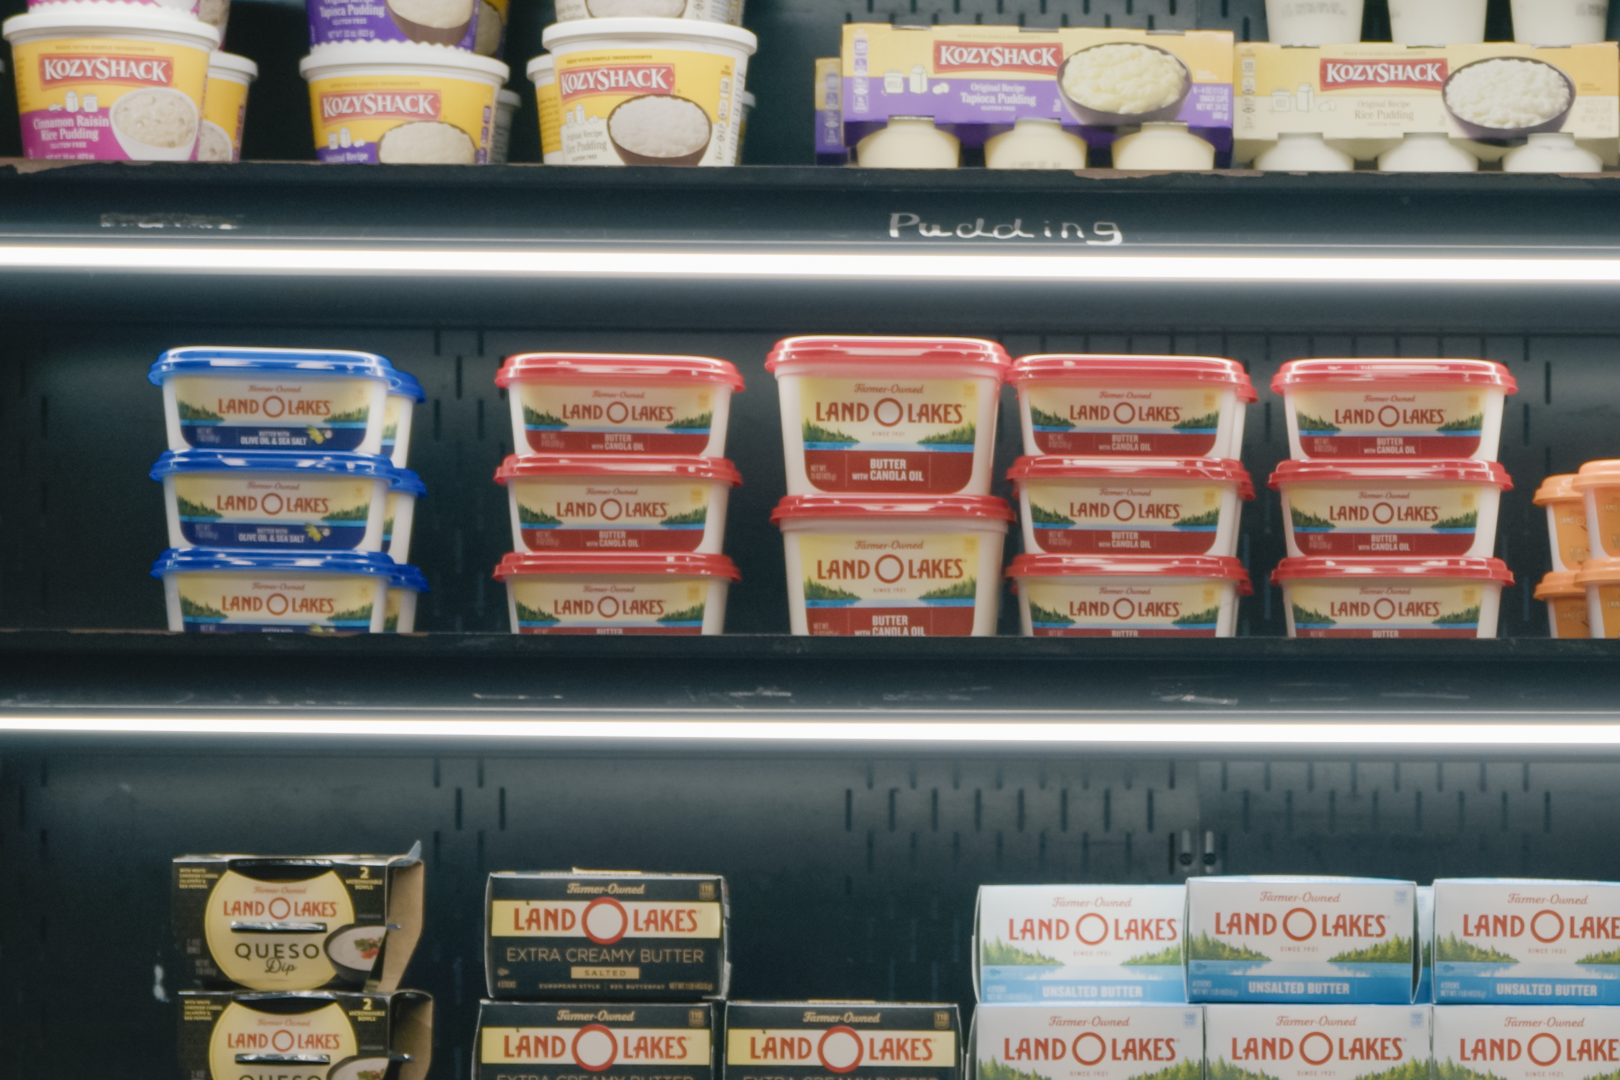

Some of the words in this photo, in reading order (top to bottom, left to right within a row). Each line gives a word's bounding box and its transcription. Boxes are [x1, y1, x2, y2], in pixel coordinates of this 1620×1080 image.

[939, 45, 1058, 67] KOZYSHACK
[43, 58, 169, 84] KOZYSHACK
[1326, 63, 1443, 83] KOZYSHACK
[561, 68, 668, 95] KOZYSHACK
[971, 83, 997, 94] Original
[999, 84, 1026, 94] Recipe
[322, 94, 434, 119] KOZYSHACK
[961, 92, 995, 105] Tapioca
[997, 93, 1036, 106] Pudding
[33, 117, 75, 130] Cinnamon
[77, 115, 109, 128] Raisin
[1355, 109, 1376, 120] Rice
[1378, 110, 1414, 121] Pudding
[41, 128, 58, 141] Rice
[59, 128, 99, 142] Pudding
[888, 212, 1123, 246] Pudding
[854, 383, 924, 395] Farmer-Owned
[218, 398, 259, 416] LAND
[288, 399, 331, 416] LAKES
[815, 402, 869, 422] LAND
[907, 403, 963, 424] LAKES
[870, 459, 906, 470] BUTTER
[852, 473, 868, 481] WITH
[870, 470, 907, 481] CANOLA
[909, 471, 924, 482] OIL
[360, 867, 370, 878] 2
[567, 883, 646, 895] Farmer-Owned
[1260, 891, 1341, 903] Farmer-Owned
[223, 901, 265, 917] LAND
[294, 901, 337, 917] LAKES
[514, 908, 576, 931] LAND
[633, 909, 698, 933] LAKES
[1215, 912, 1277, 935] LAND
[1321, 914, 1387, 938] LAKES
[235, 943, 320, 961] QUESO
[507, 948, 561, 962] EXTRA
[566, 949, 636, 963] CREAMY
[640, 950, 704, 963] BUTTER
[265, 957, 297, 975] Dip
[584, 969, 626, 977] SALTED
[1248, 981, 1304, 994] UNSALTED
[1307, 982, 1350, 995] BUTTER
